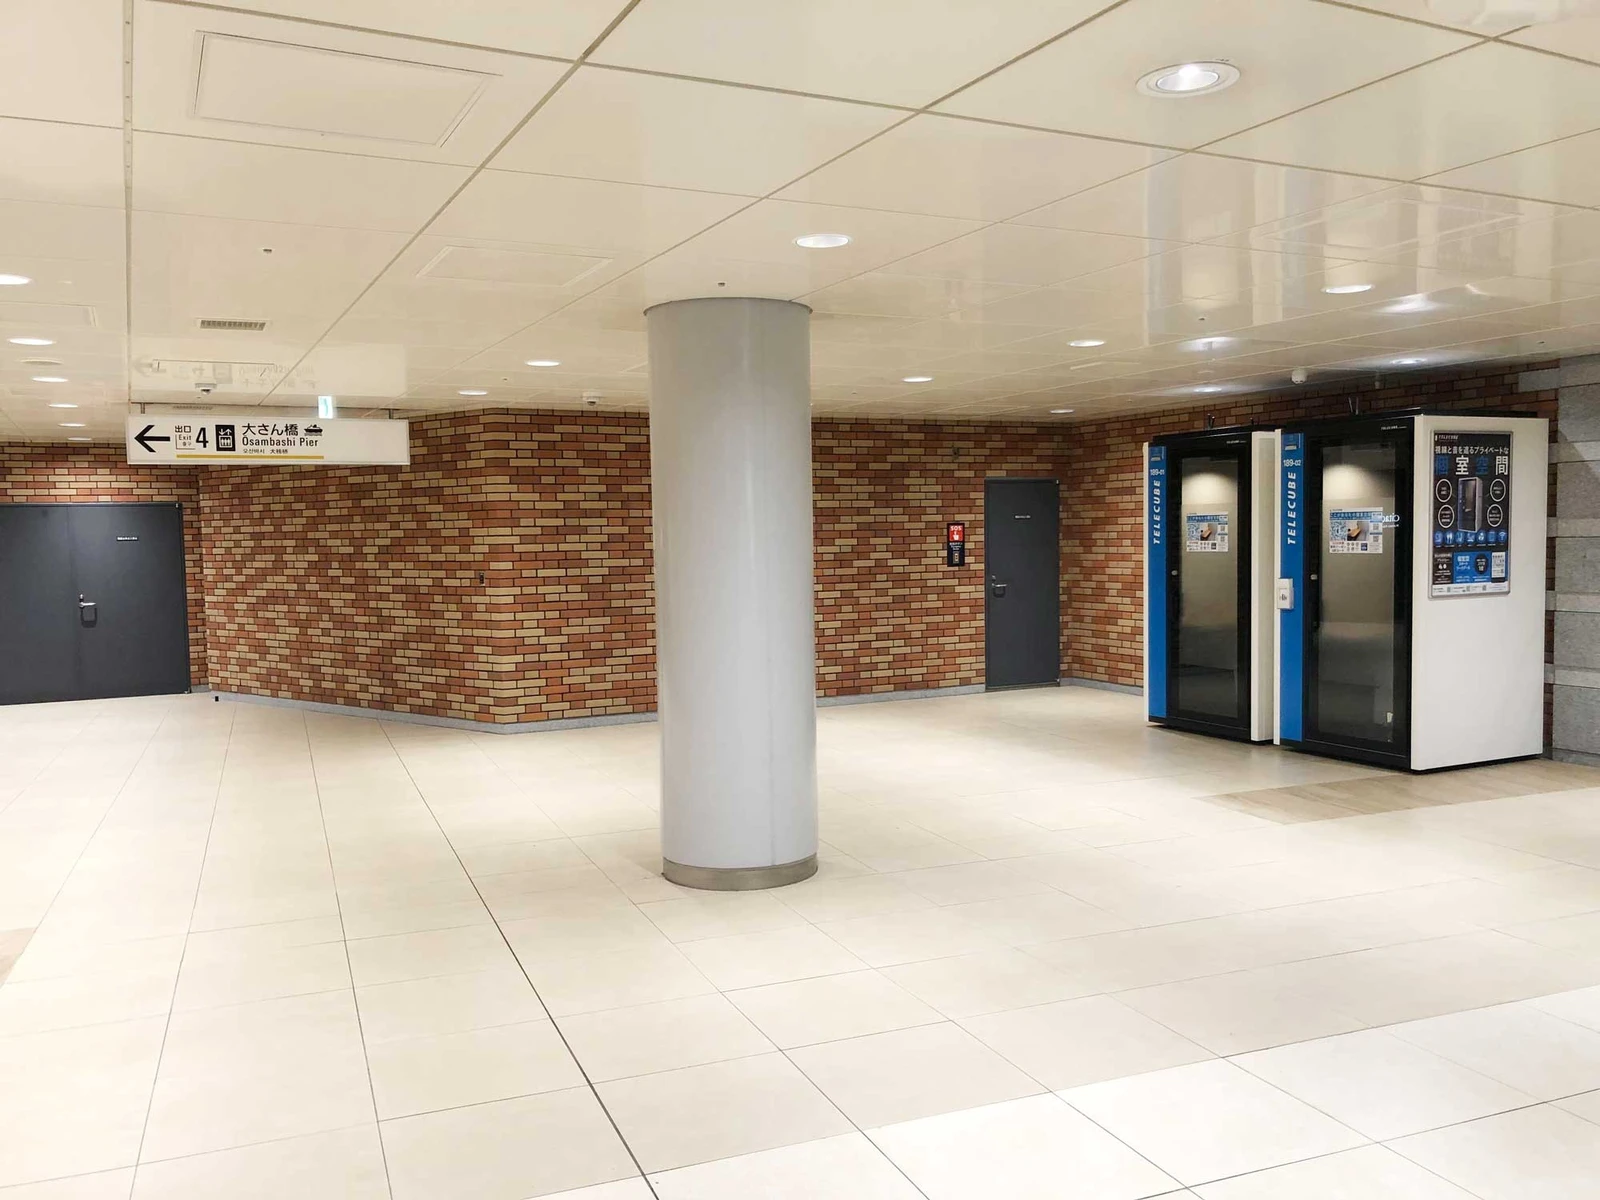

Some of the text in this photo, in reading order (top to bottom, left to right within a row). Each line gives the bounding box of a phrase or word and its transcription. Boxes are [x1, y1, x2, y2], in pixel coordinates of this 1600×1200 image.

[174, 425, 192, 433] 出口
[242, 423, 298, 436] 大さん橋
[195, 427, 209, 449] 4
[299, 437, 318, 447] Pier
[1153, 480, 1161, 545] TELECUBE
[1287, 471, 1296, 545] TELECUBE
